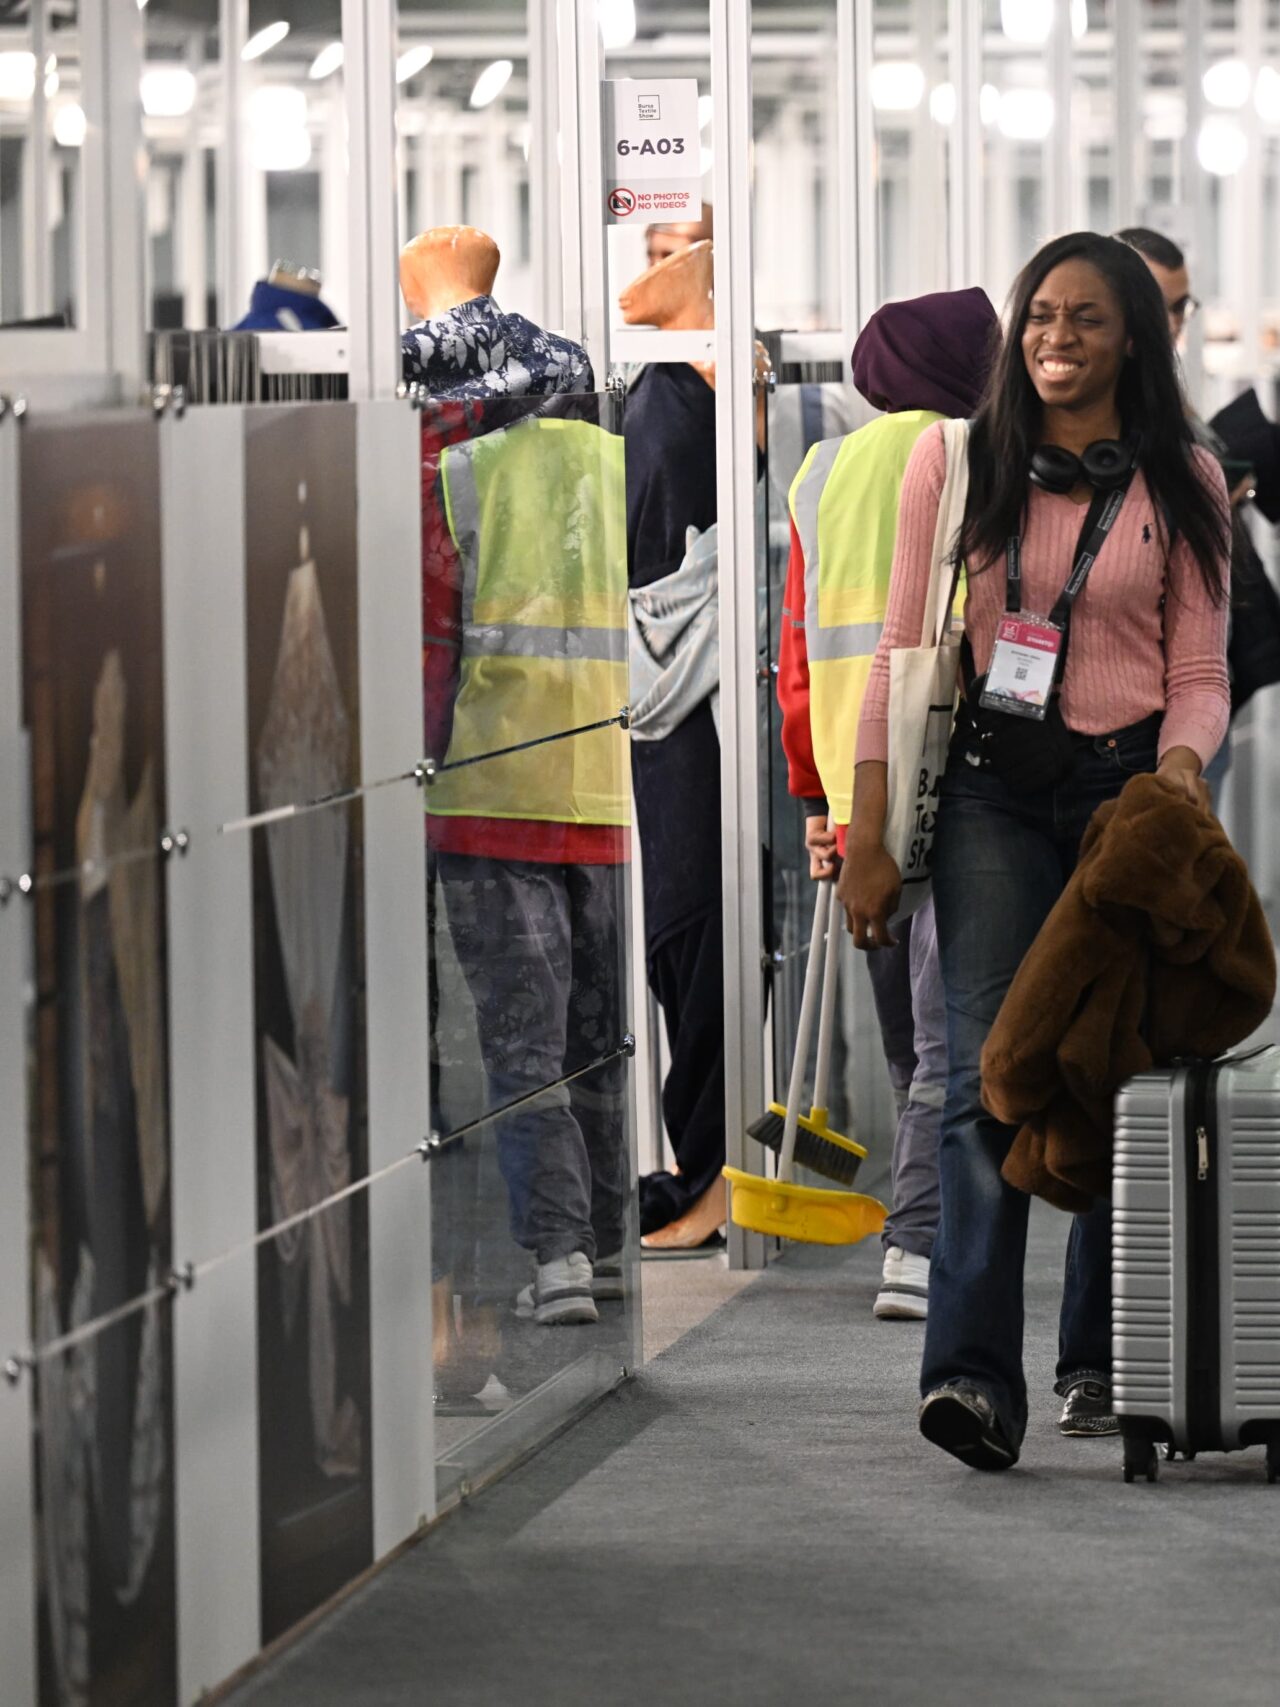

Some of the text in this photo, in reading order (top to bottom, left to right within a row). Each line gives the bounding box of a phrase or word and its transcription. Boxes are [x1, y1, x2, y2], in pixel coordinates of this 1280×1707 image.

[617, 137, 685, 156] 6-A03
[637, 192, 690, 201] NO PHOTOS
[637, 201, 687, 210] NO VIDEOS
